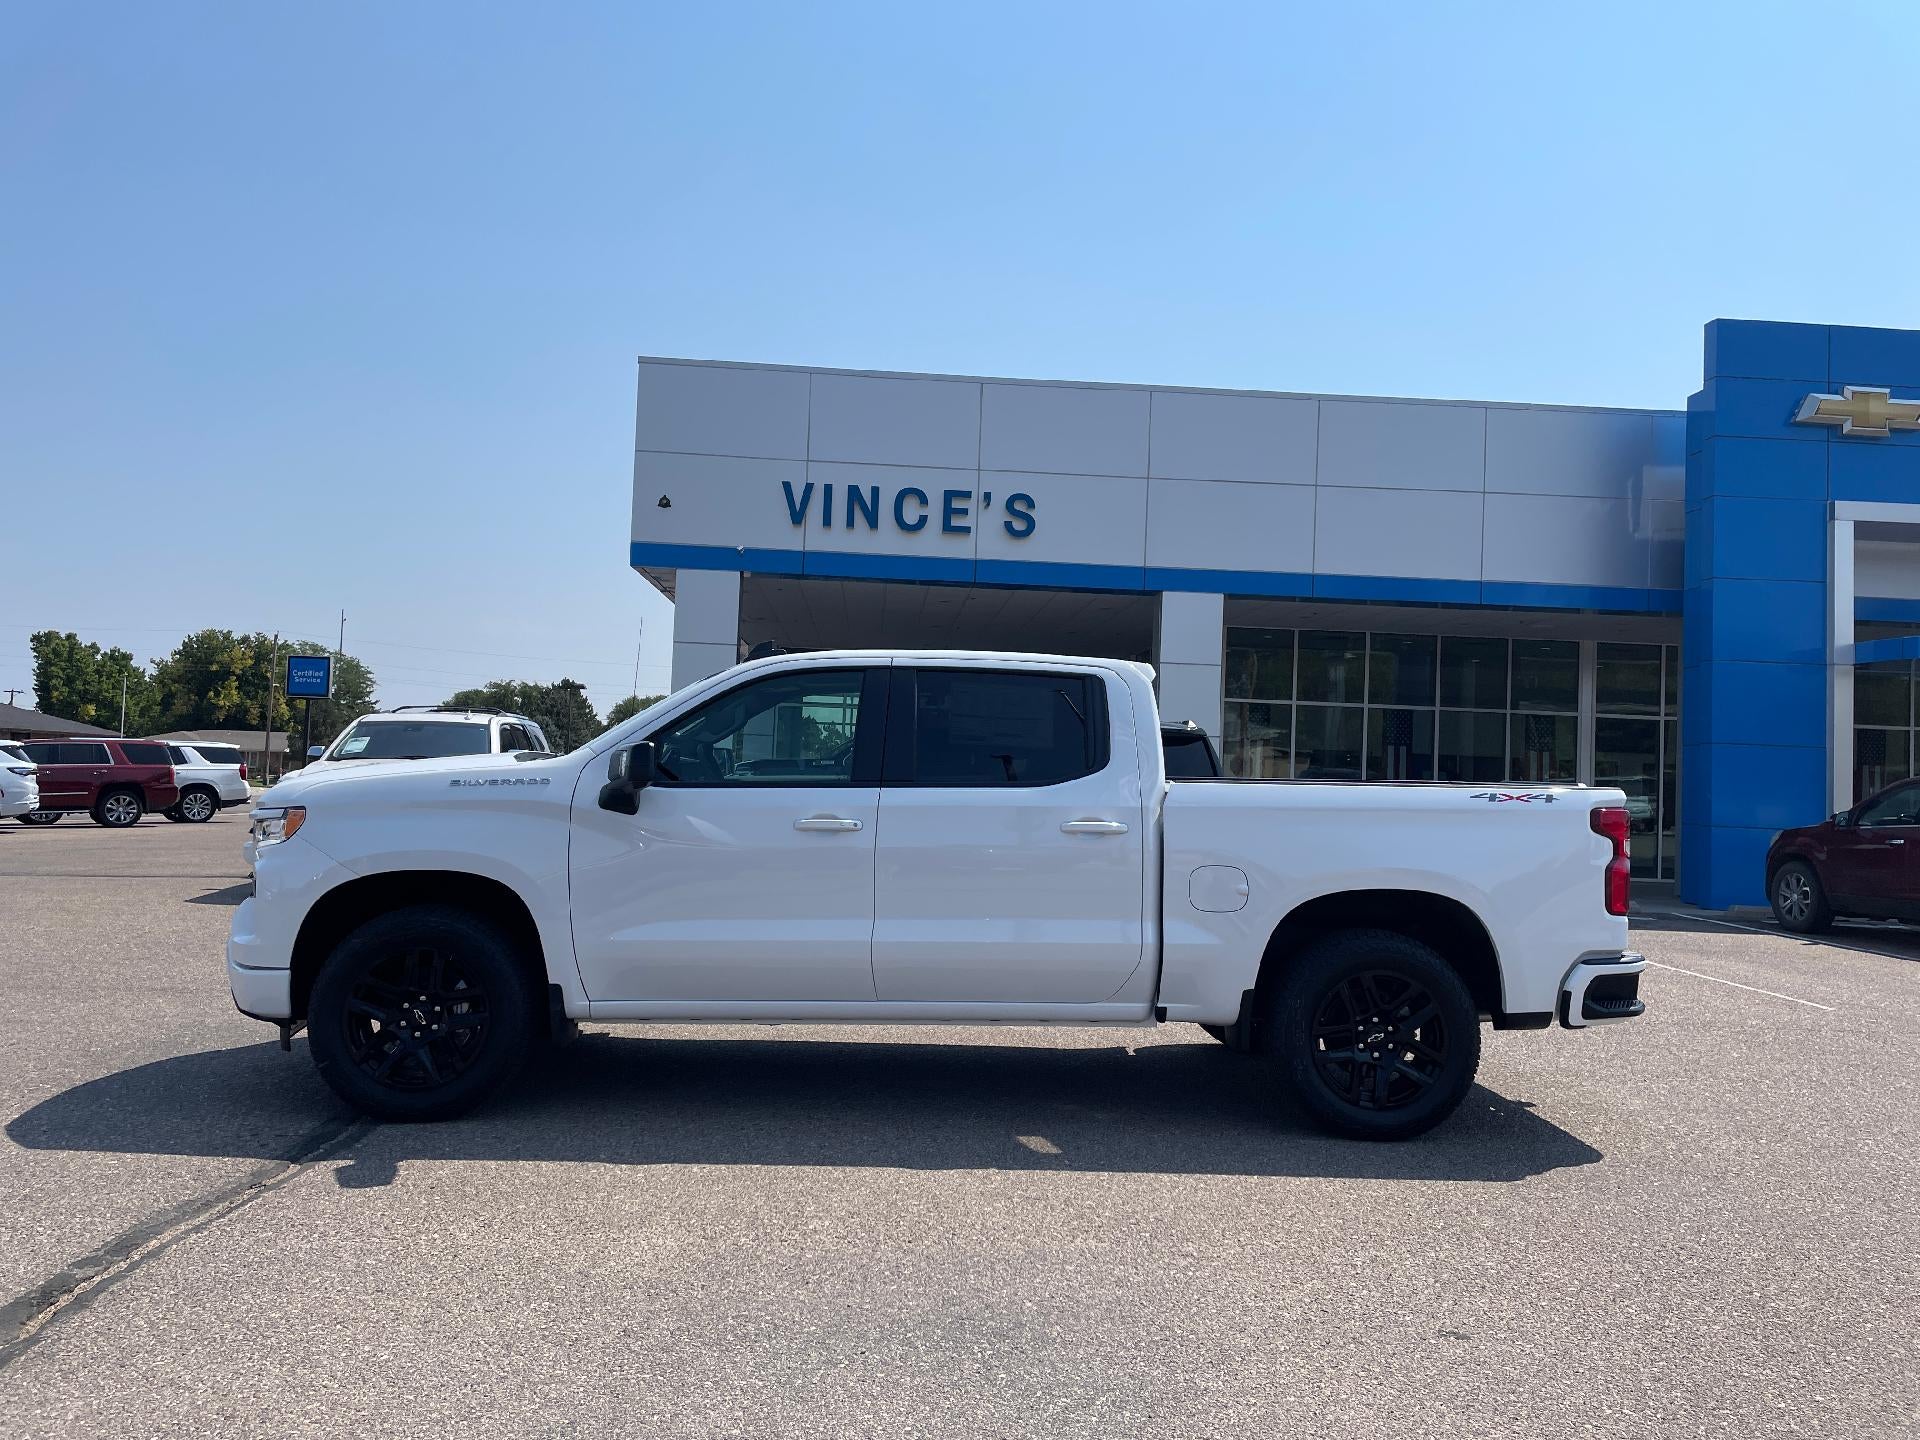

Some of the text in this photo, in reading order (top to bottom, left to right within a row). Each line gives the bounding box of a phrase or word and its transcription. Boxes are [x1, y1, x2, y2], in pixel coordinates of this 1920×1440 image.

[781, 480, 1036, 538] VINCE'S
[292, 669, 324, 677] Certified
[449, 778, 552, 787] SILVERADO
